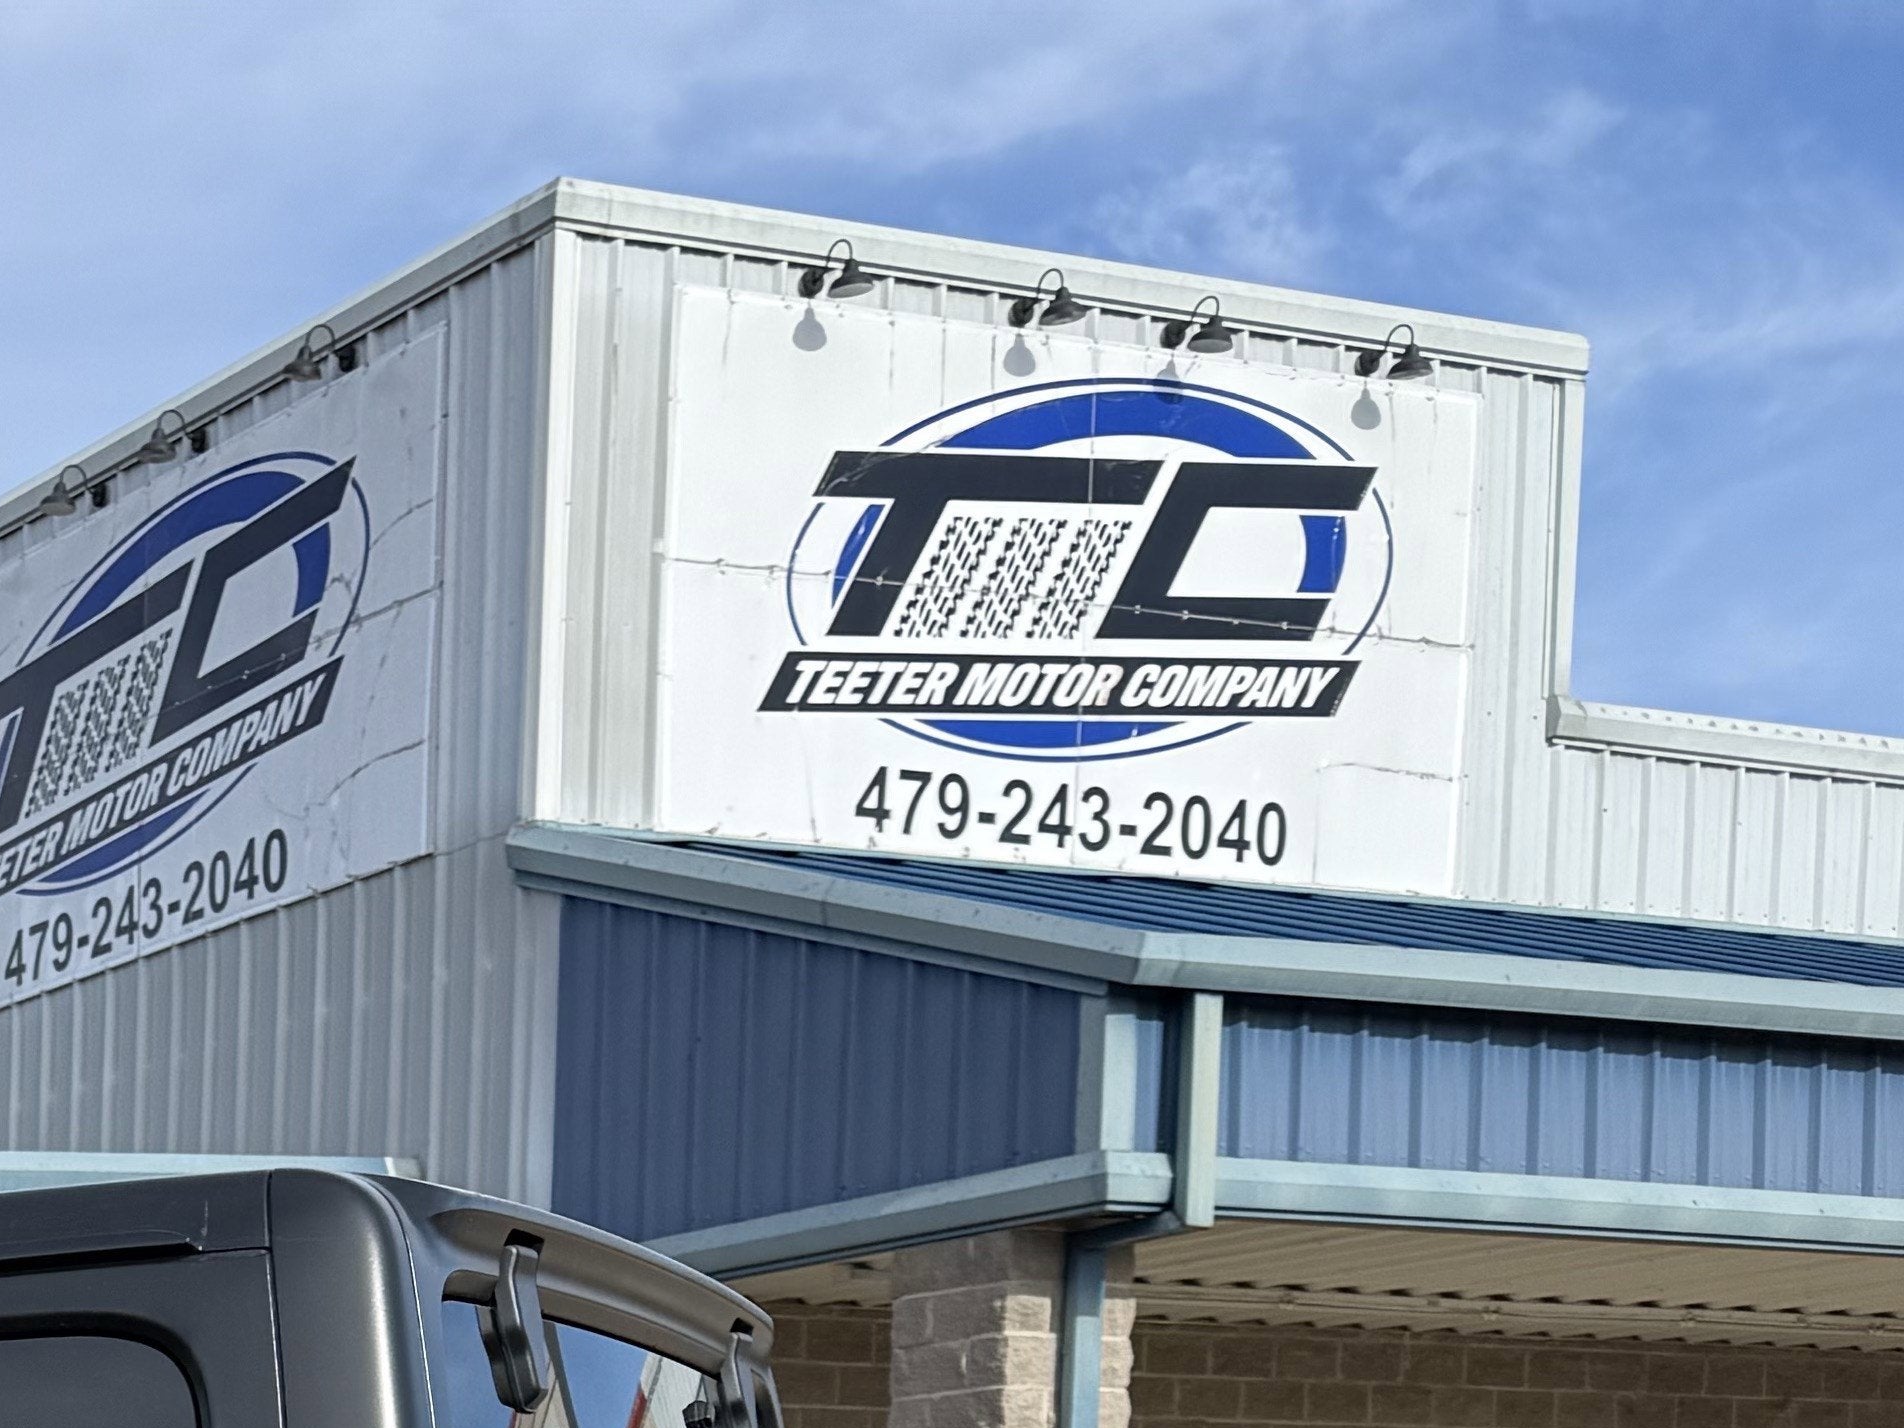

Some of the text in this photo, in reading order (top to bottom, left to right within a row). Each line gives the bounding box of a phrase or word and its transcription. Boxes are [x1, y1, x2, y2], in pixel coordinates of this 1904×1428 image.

[785, 660, 1340, 710] TEETER MOTOR COMPANY
[60, 771, 168, 854] MOTOR
[166, 673, 327, 797] COMPANY
[854, 765, 1287, 867] 479-243-2040
[3, 827, 289, 988] 479-243-2040
